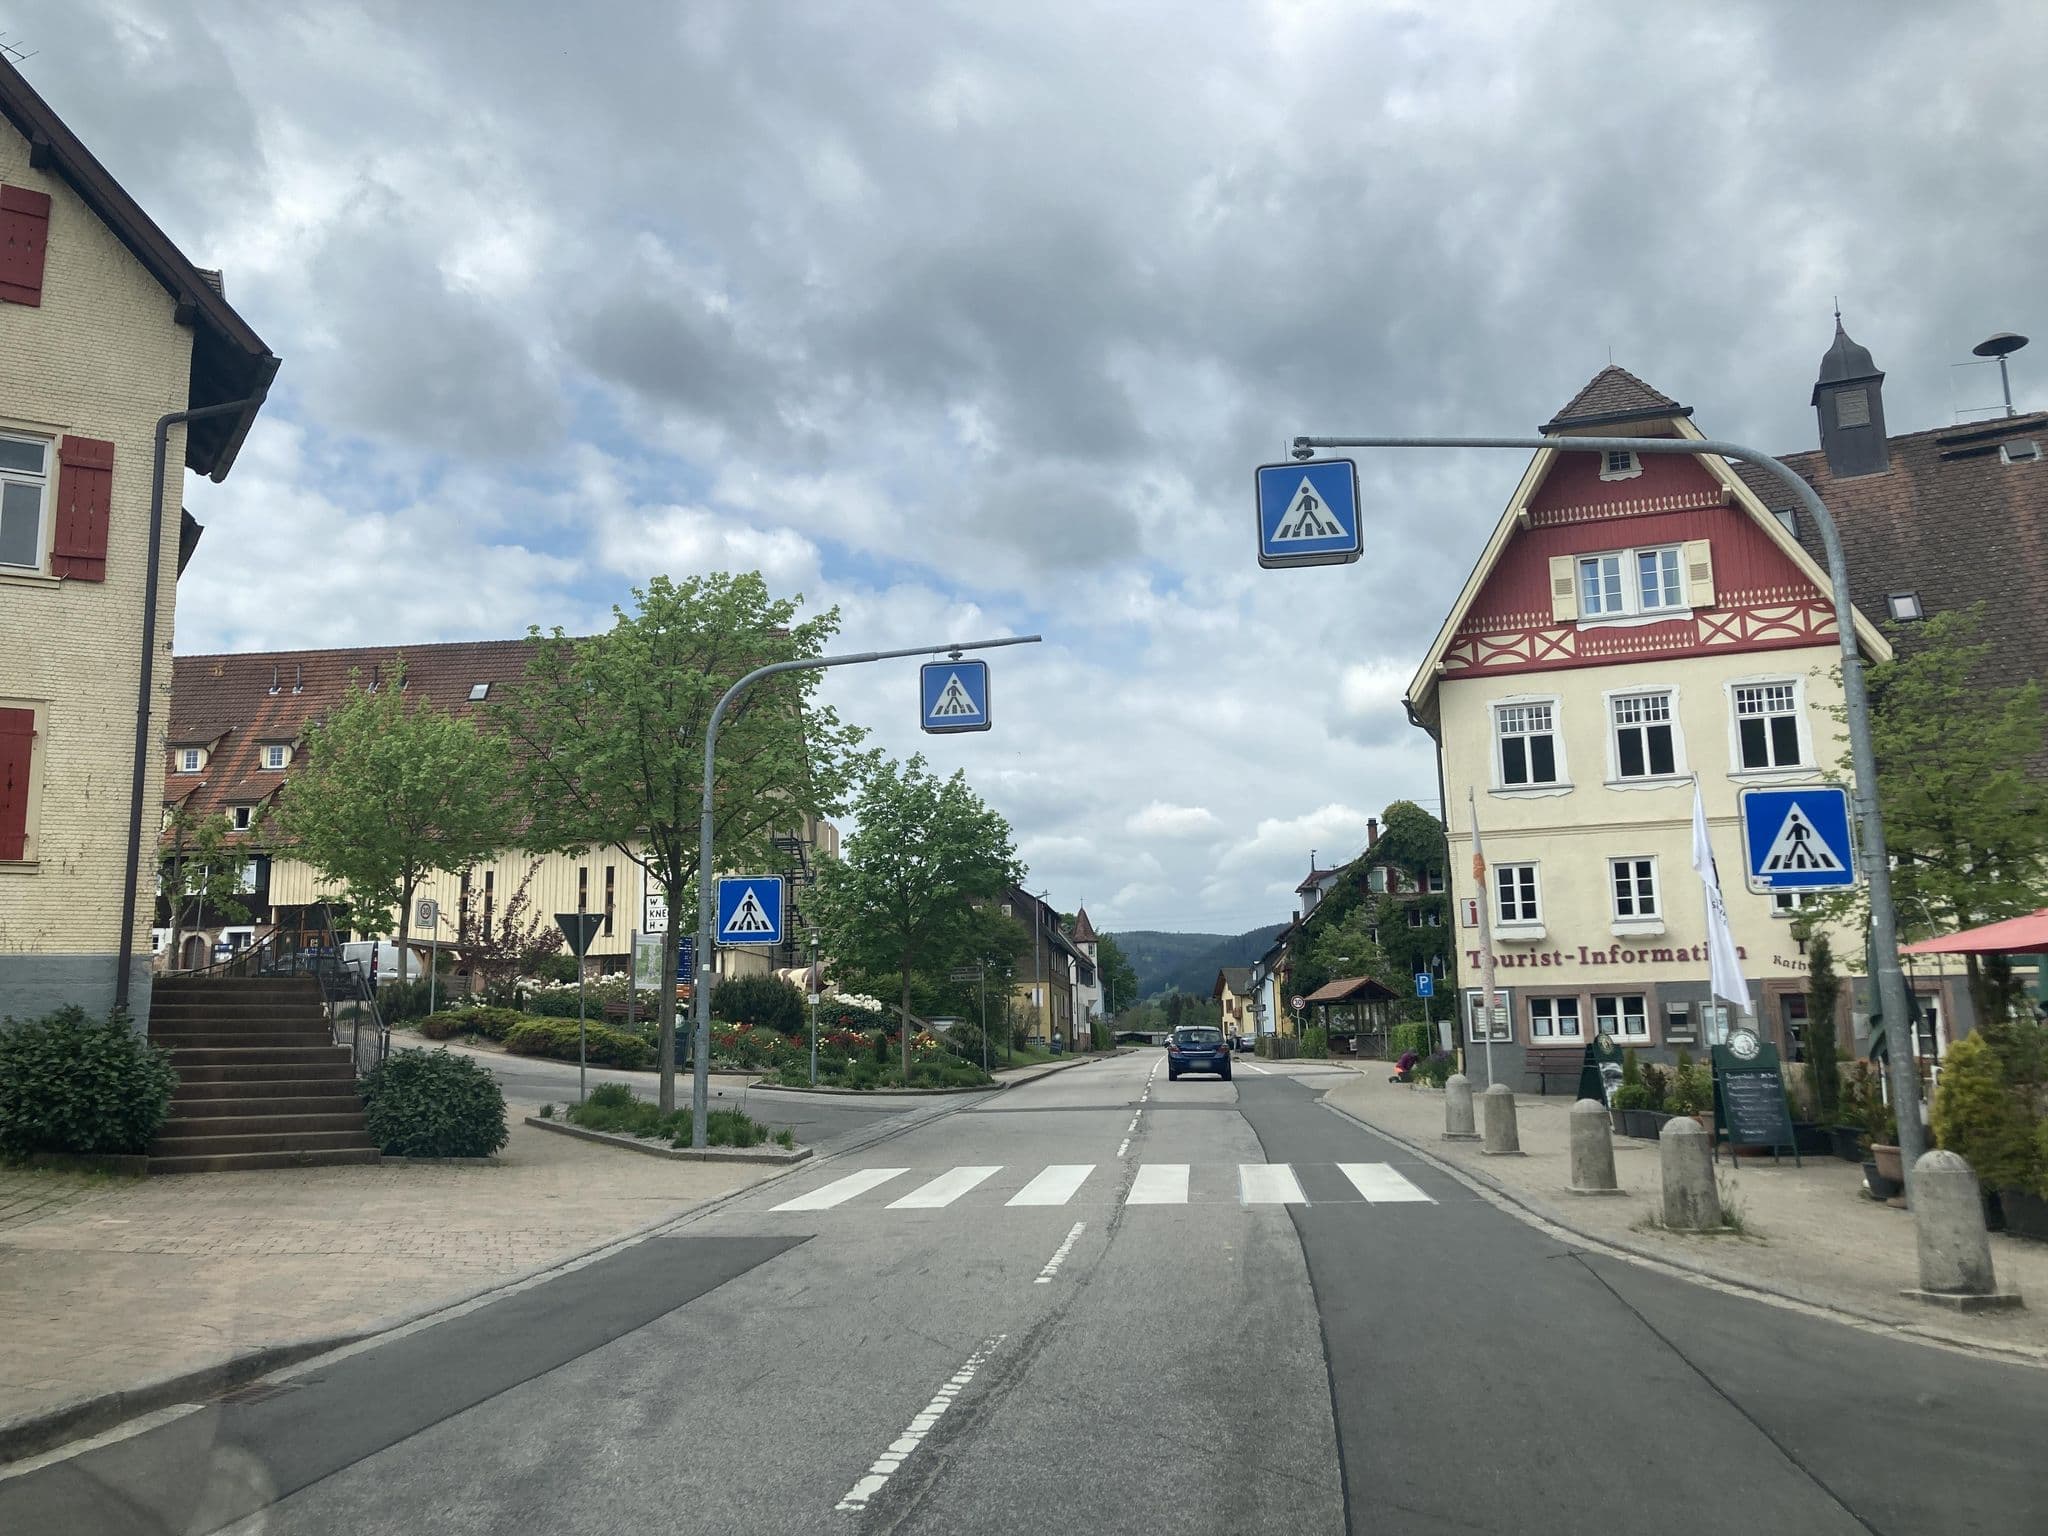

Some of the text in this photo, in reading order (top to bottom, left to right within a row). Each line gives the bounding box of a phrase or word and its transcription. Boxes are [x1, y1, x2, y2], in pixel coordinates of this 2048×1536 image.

[649, 908, 667, 918] KNE
[1466, 942, 1747, 969] Turist-Informatin
[1773, 955, 1811, 972] Rath
[1418, 975, 1429, 989] P
